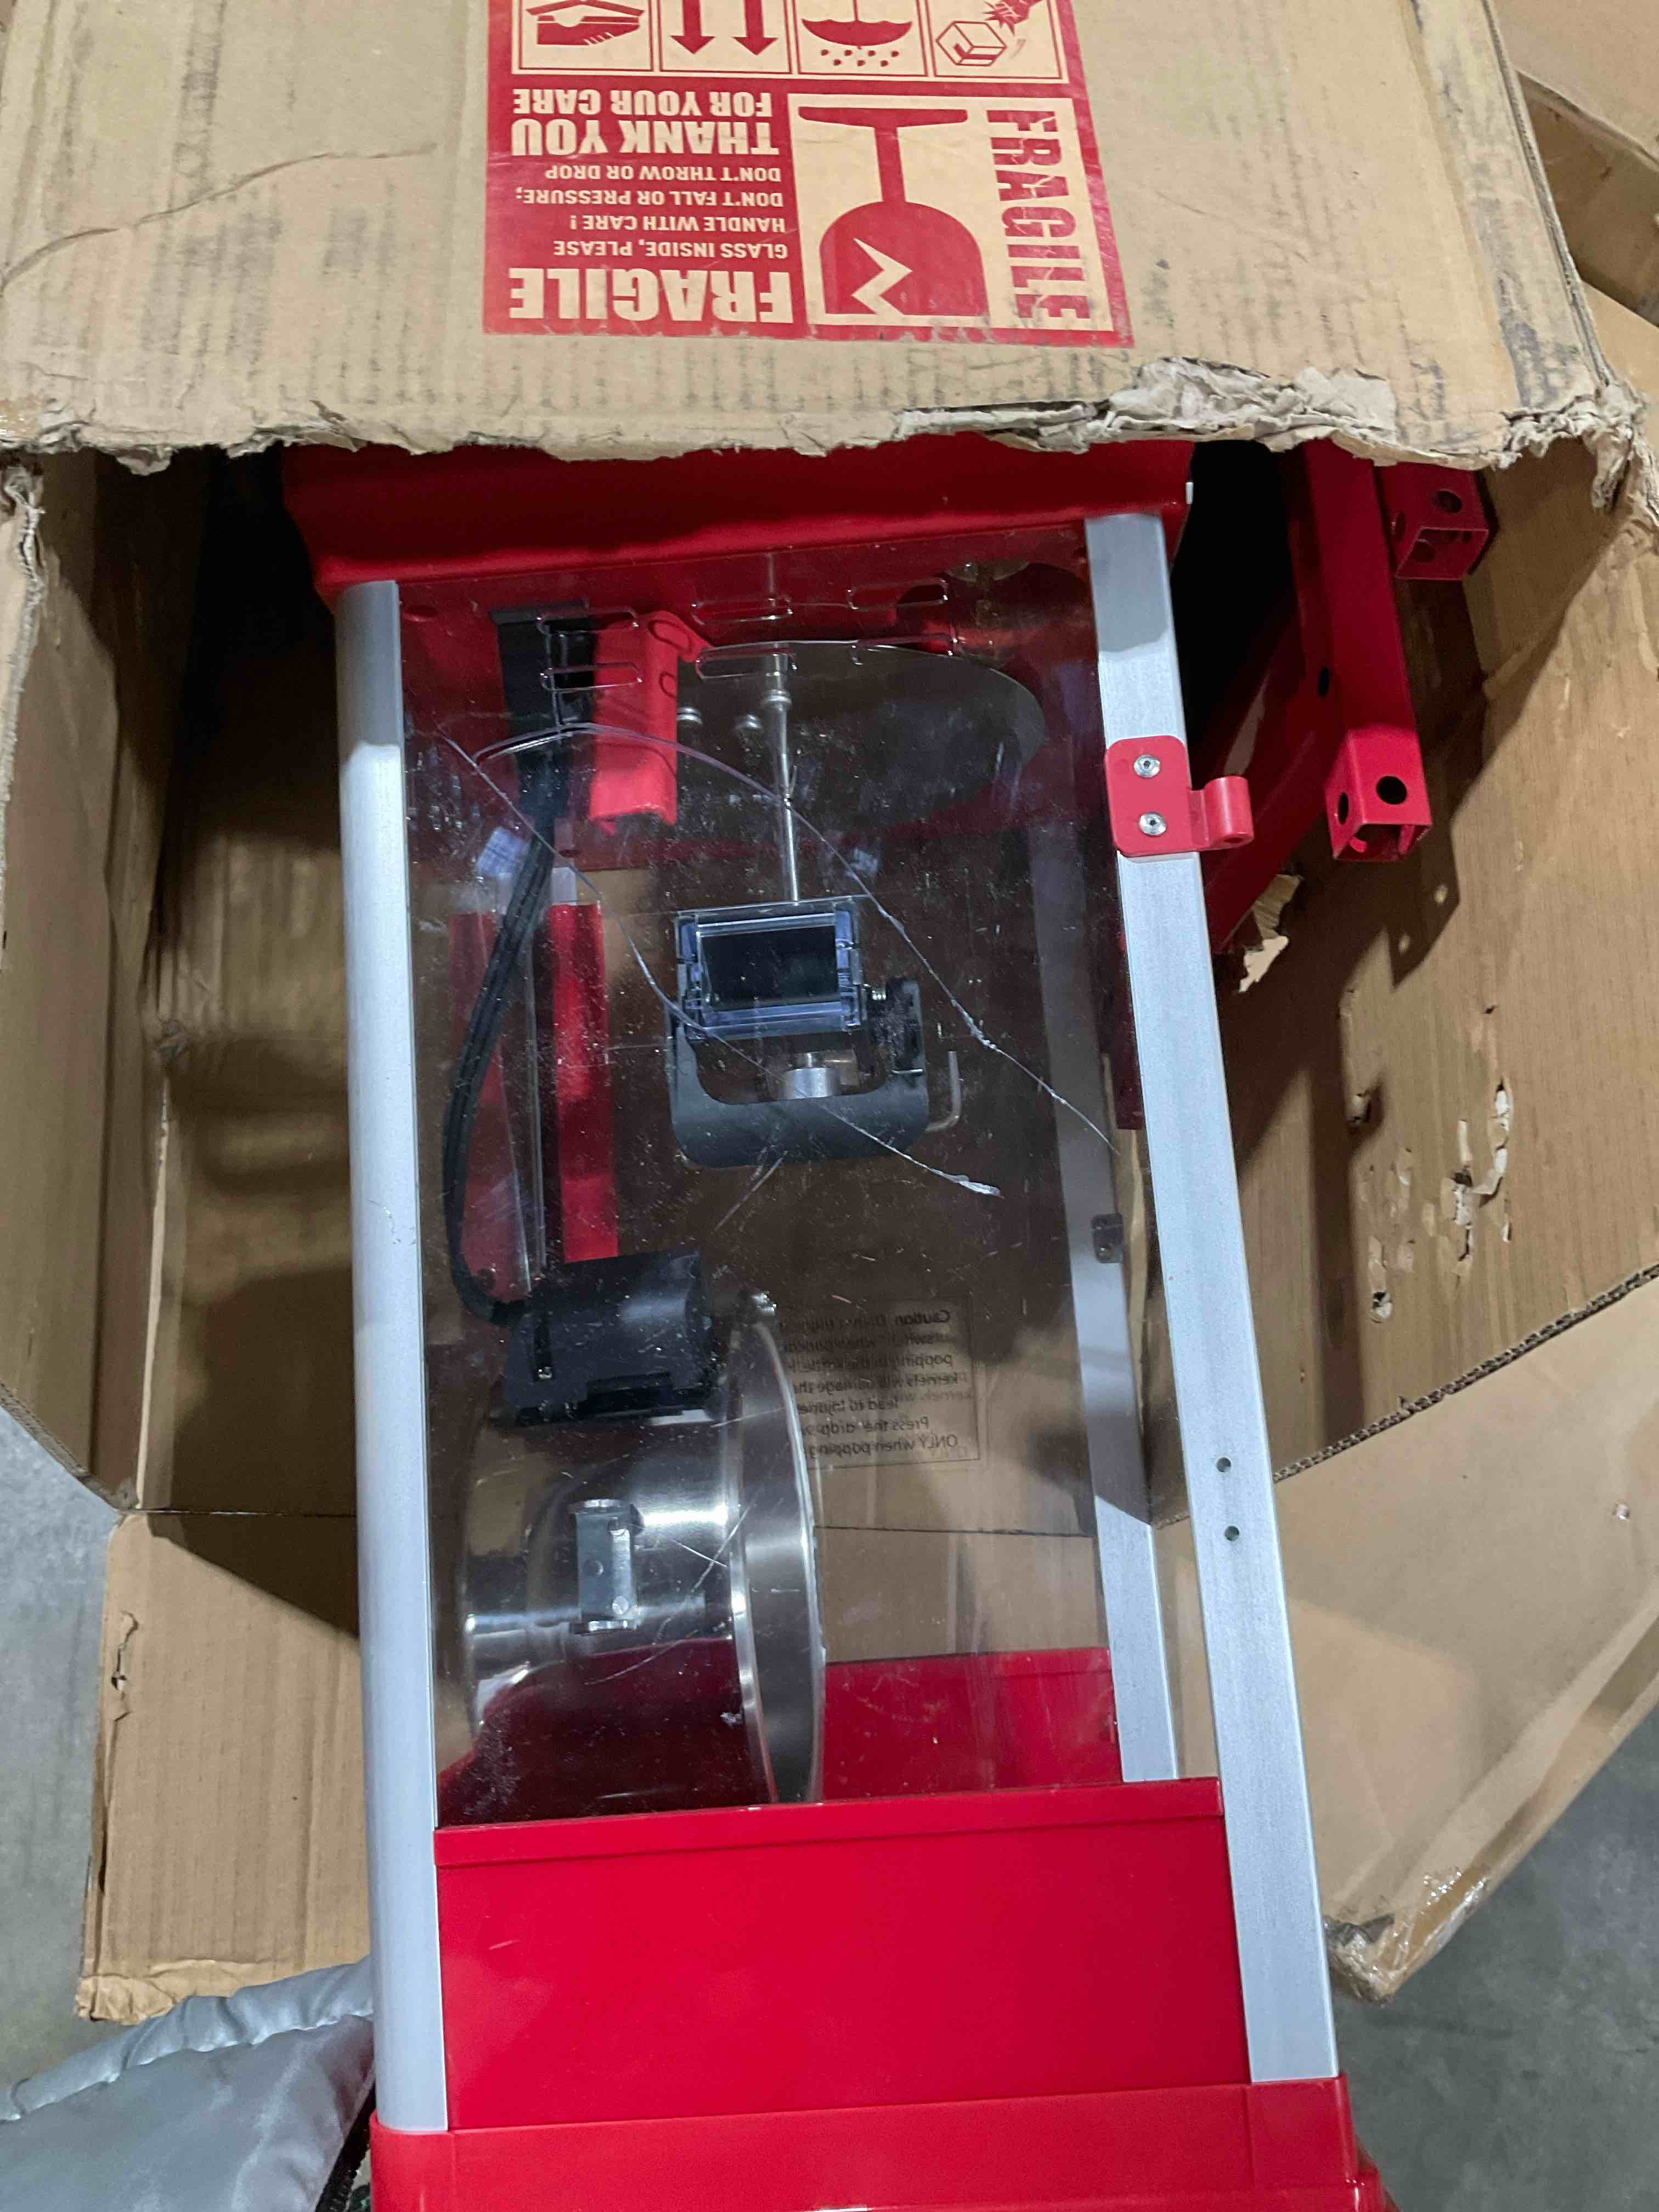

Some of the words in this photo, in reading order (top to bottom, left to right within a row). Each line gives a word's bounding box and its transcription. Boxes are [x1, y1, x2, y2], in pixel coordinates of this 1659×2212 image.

[513, 88, 601, 115] CARE
[610, 90, 703, 116] YOUR
[709, 92, 772, 117] FOR
[511, 119, 607, 156] YOU
[618, 120, 780, 155] THANK
[545, 165, 601, 180] DROP
[607, 166, 634, 180] OR
[640, 166, 716, 181] THROW
[721, 167, 781, 182] DON'T
[516, 187, 631, 204] PRESSURE;
[637, 190, 665, 205] OR
[670, 191, 716, 206] FALL
[723, 191, 783, 207] DON'T
[987, 110, 1090, 319] FRAGILE
[643, 216, 698, 231] WITH
[704, 217, 786, 233] HANDLE
[553, 241, 633, 256] PLEASE
[639, 239, 715, 257] INSIDE,
[721, 243, 788, 259] GLASS
[509, 268, 793, 324] FRAGILE
